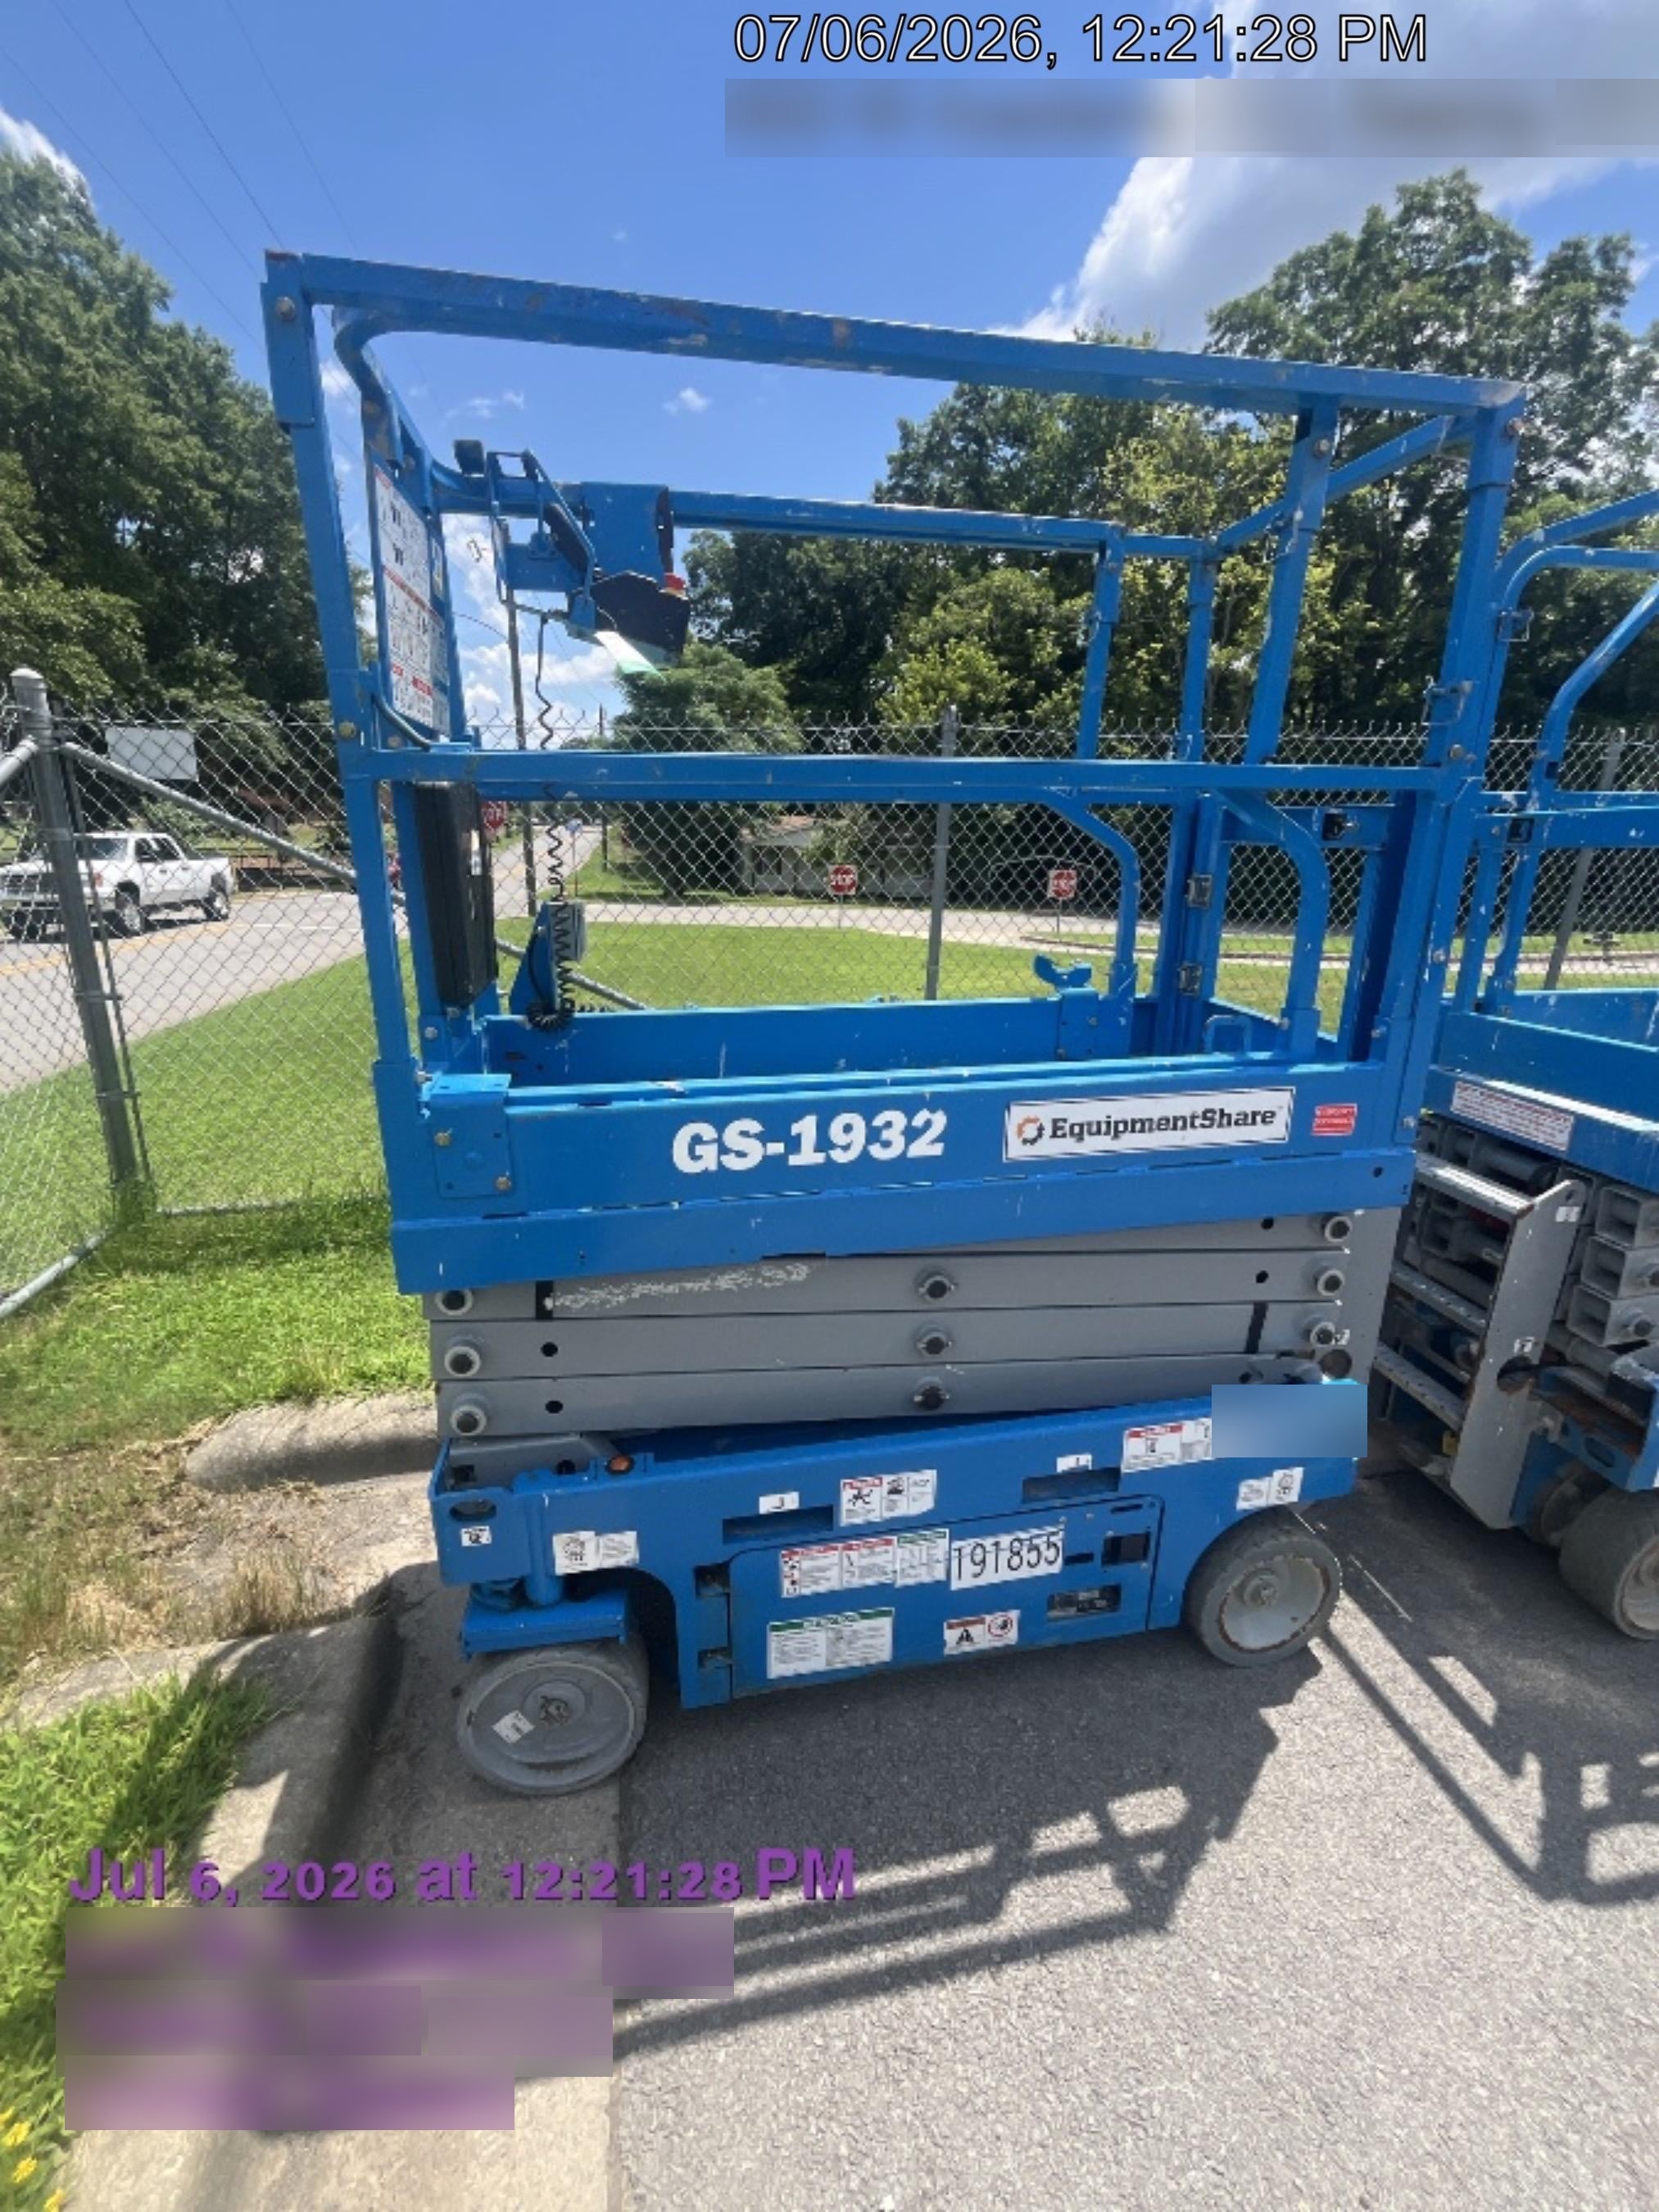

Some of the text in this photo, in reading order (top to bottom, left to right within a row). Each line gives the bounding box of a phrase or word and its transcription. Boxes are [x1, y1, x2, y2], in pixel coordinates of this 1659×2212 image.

[672, 1108, 948, 1174] GS-1932
[1049, 1108, 1277, 1141] EquipmentShare
[953, 1529, 1060, 1581] 191855
